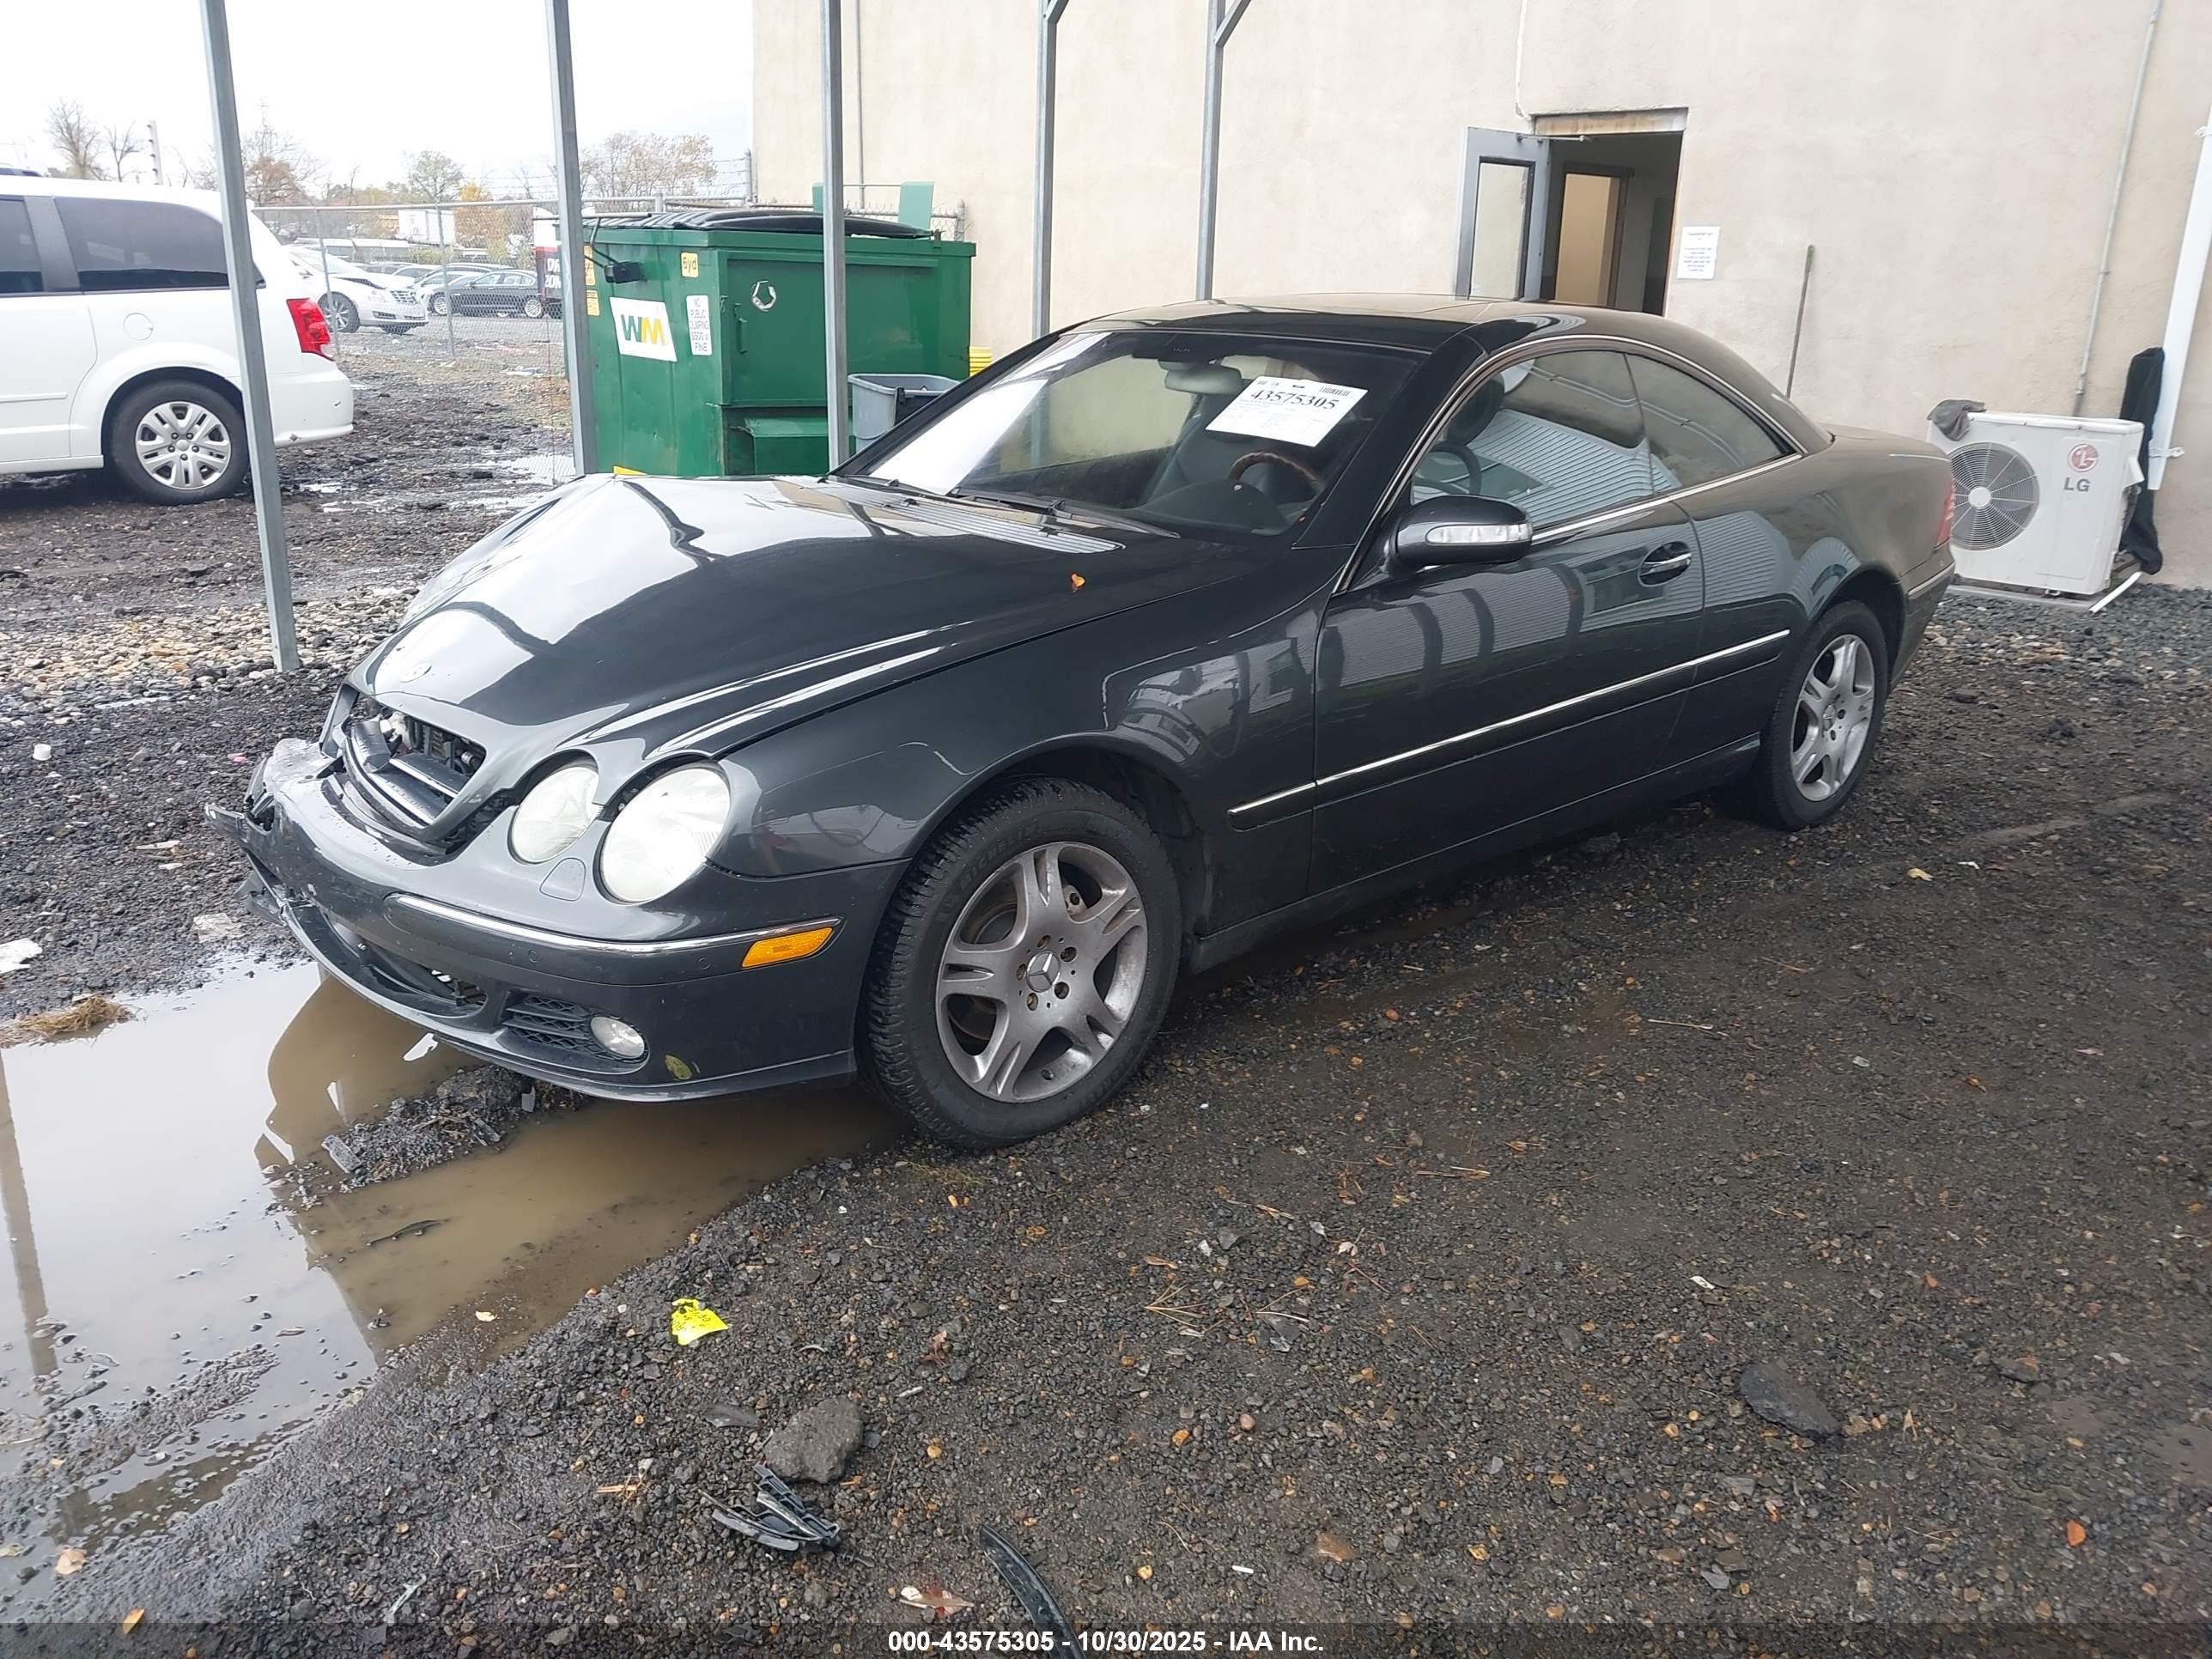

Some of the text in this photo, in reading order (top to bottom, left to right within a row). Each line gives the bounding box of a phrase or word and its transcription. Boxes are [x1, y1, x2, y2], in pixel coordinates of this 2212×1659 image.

[547, 258, 561, 273] DR
[683, 257, 697, 274] 6yd
[544, 274, 562, 289] ZON
[620, 313, 667, 346] WM
[1250, 389, 1340, 410] 43575305
[2063, 477, 2091, 492] LG
